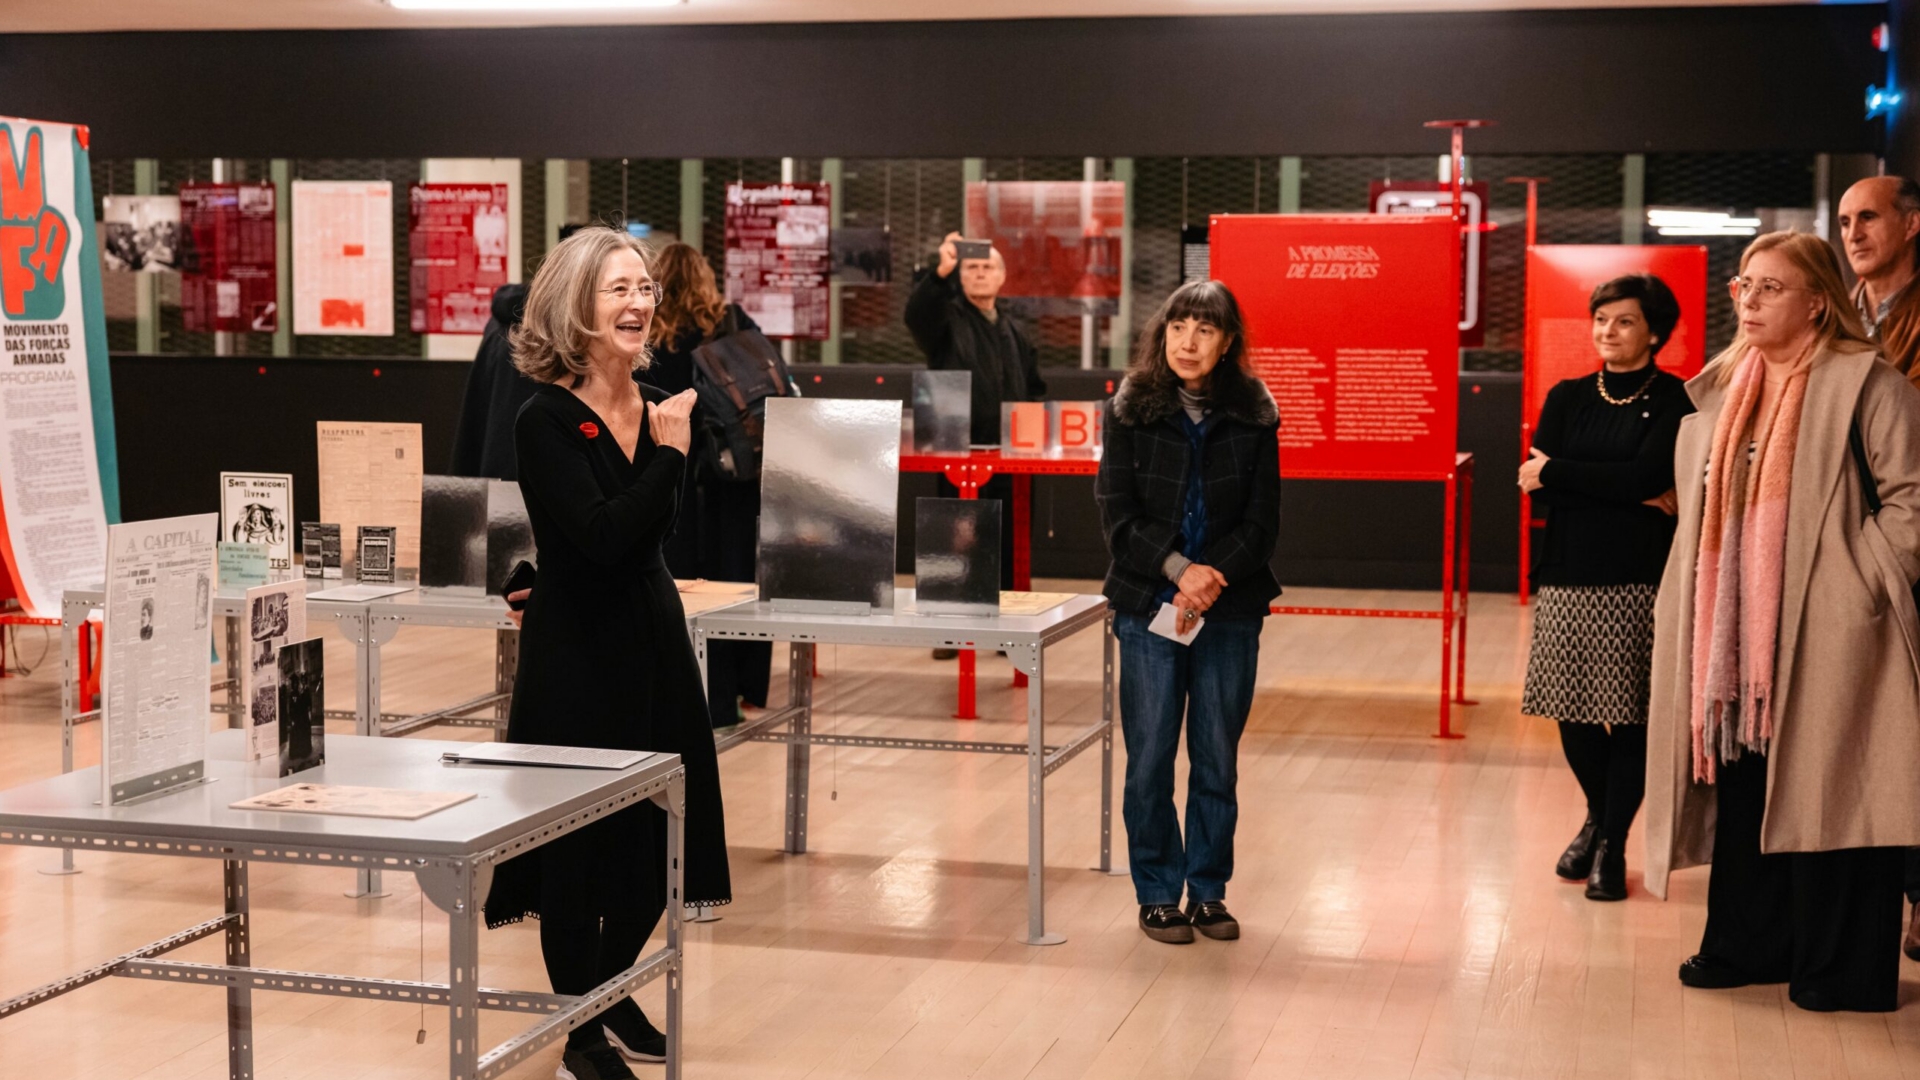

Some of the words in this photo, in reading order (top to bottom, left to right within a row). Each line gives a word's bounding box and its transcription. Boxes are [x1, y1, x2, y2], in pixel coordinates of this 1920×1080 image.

[1288, 246, 1300, 261] A
[1300, 245, 1379, 261] PROMESSA
[1286, 263, 1310, 279] DE
[1309, 261, 1380, 280] ELEIÇÕES
[4, 324, 69, 336] MOVIMENTO
[6, 339, 26, 351] DAS
[30, 338, 70, 351] FORÇAS
[14, 352, 66, 366] ARMADAS
[0, 370, 76, 385] PROGRAMA
[228, 479, 246, 487] Sem
[244, 489, 271, 499] livres
[126, 538, 137, 553] A
[143, 530, 205, 551] CAPITAL
